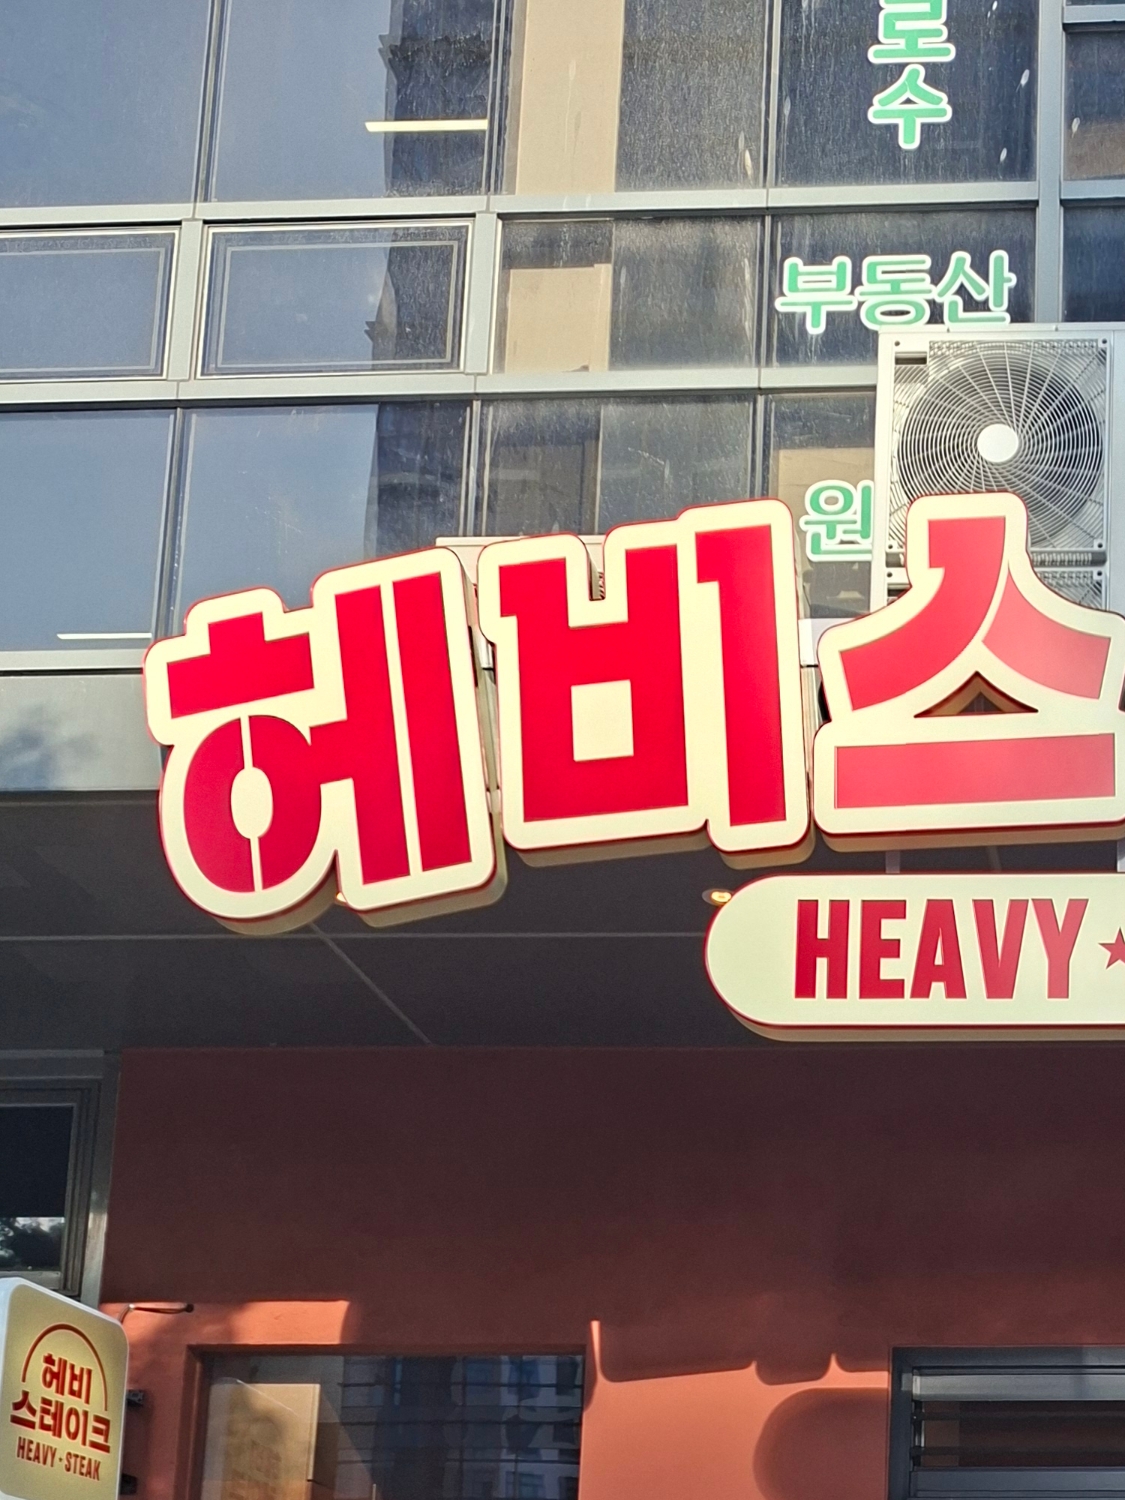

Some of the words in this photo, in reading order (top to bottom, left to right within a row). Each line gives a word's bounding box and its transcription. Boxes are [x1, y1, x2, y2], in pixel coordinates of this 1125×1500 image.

[775, 250, 1016, 334] 부동산
[793, 897, 1087, 1001] HEAVY
[42, 1353, 93, 1405] 헤비
[10, 1390, 111, 1454] 스테이크
[17, 1436, 57, 1468] HEAVY
[64, 1451, 101, 1481] STEAK
